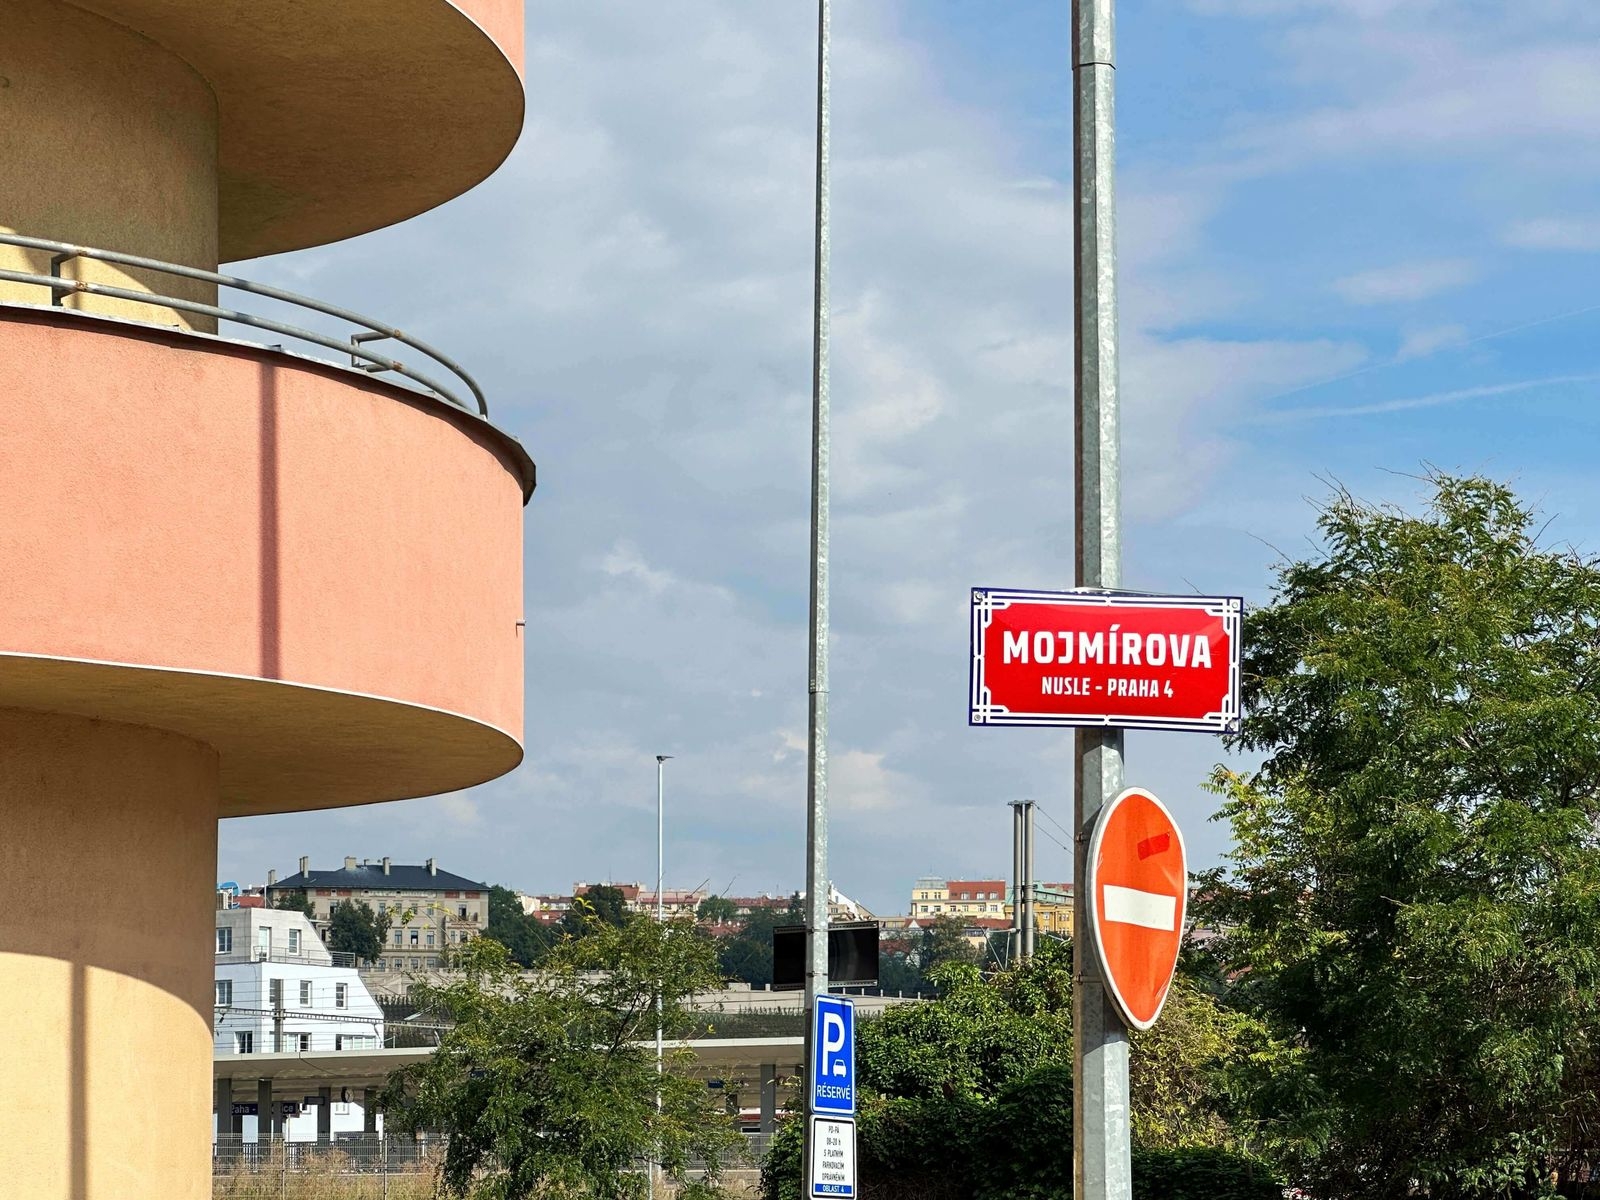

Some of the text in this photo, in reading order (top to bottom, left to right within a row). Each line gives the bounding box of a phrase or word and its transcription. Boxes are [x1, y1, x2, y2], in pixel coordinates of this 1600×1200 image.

[1002, 623, 1213, 669] MOJMÍROVA
[1041, 676, 1090, 697] NUSLE
[1107, 677, 1159, 698] PRAHA
[1163, 679, 1174, 698] 4
[822, 1012, 845, 1076] P
[816, 1082, 851, 1100] RÉSERVÉ
[822, 1160, 845, 1170] PARKOVACÍM
[822, 1185, 840, 1193] OBLAST
